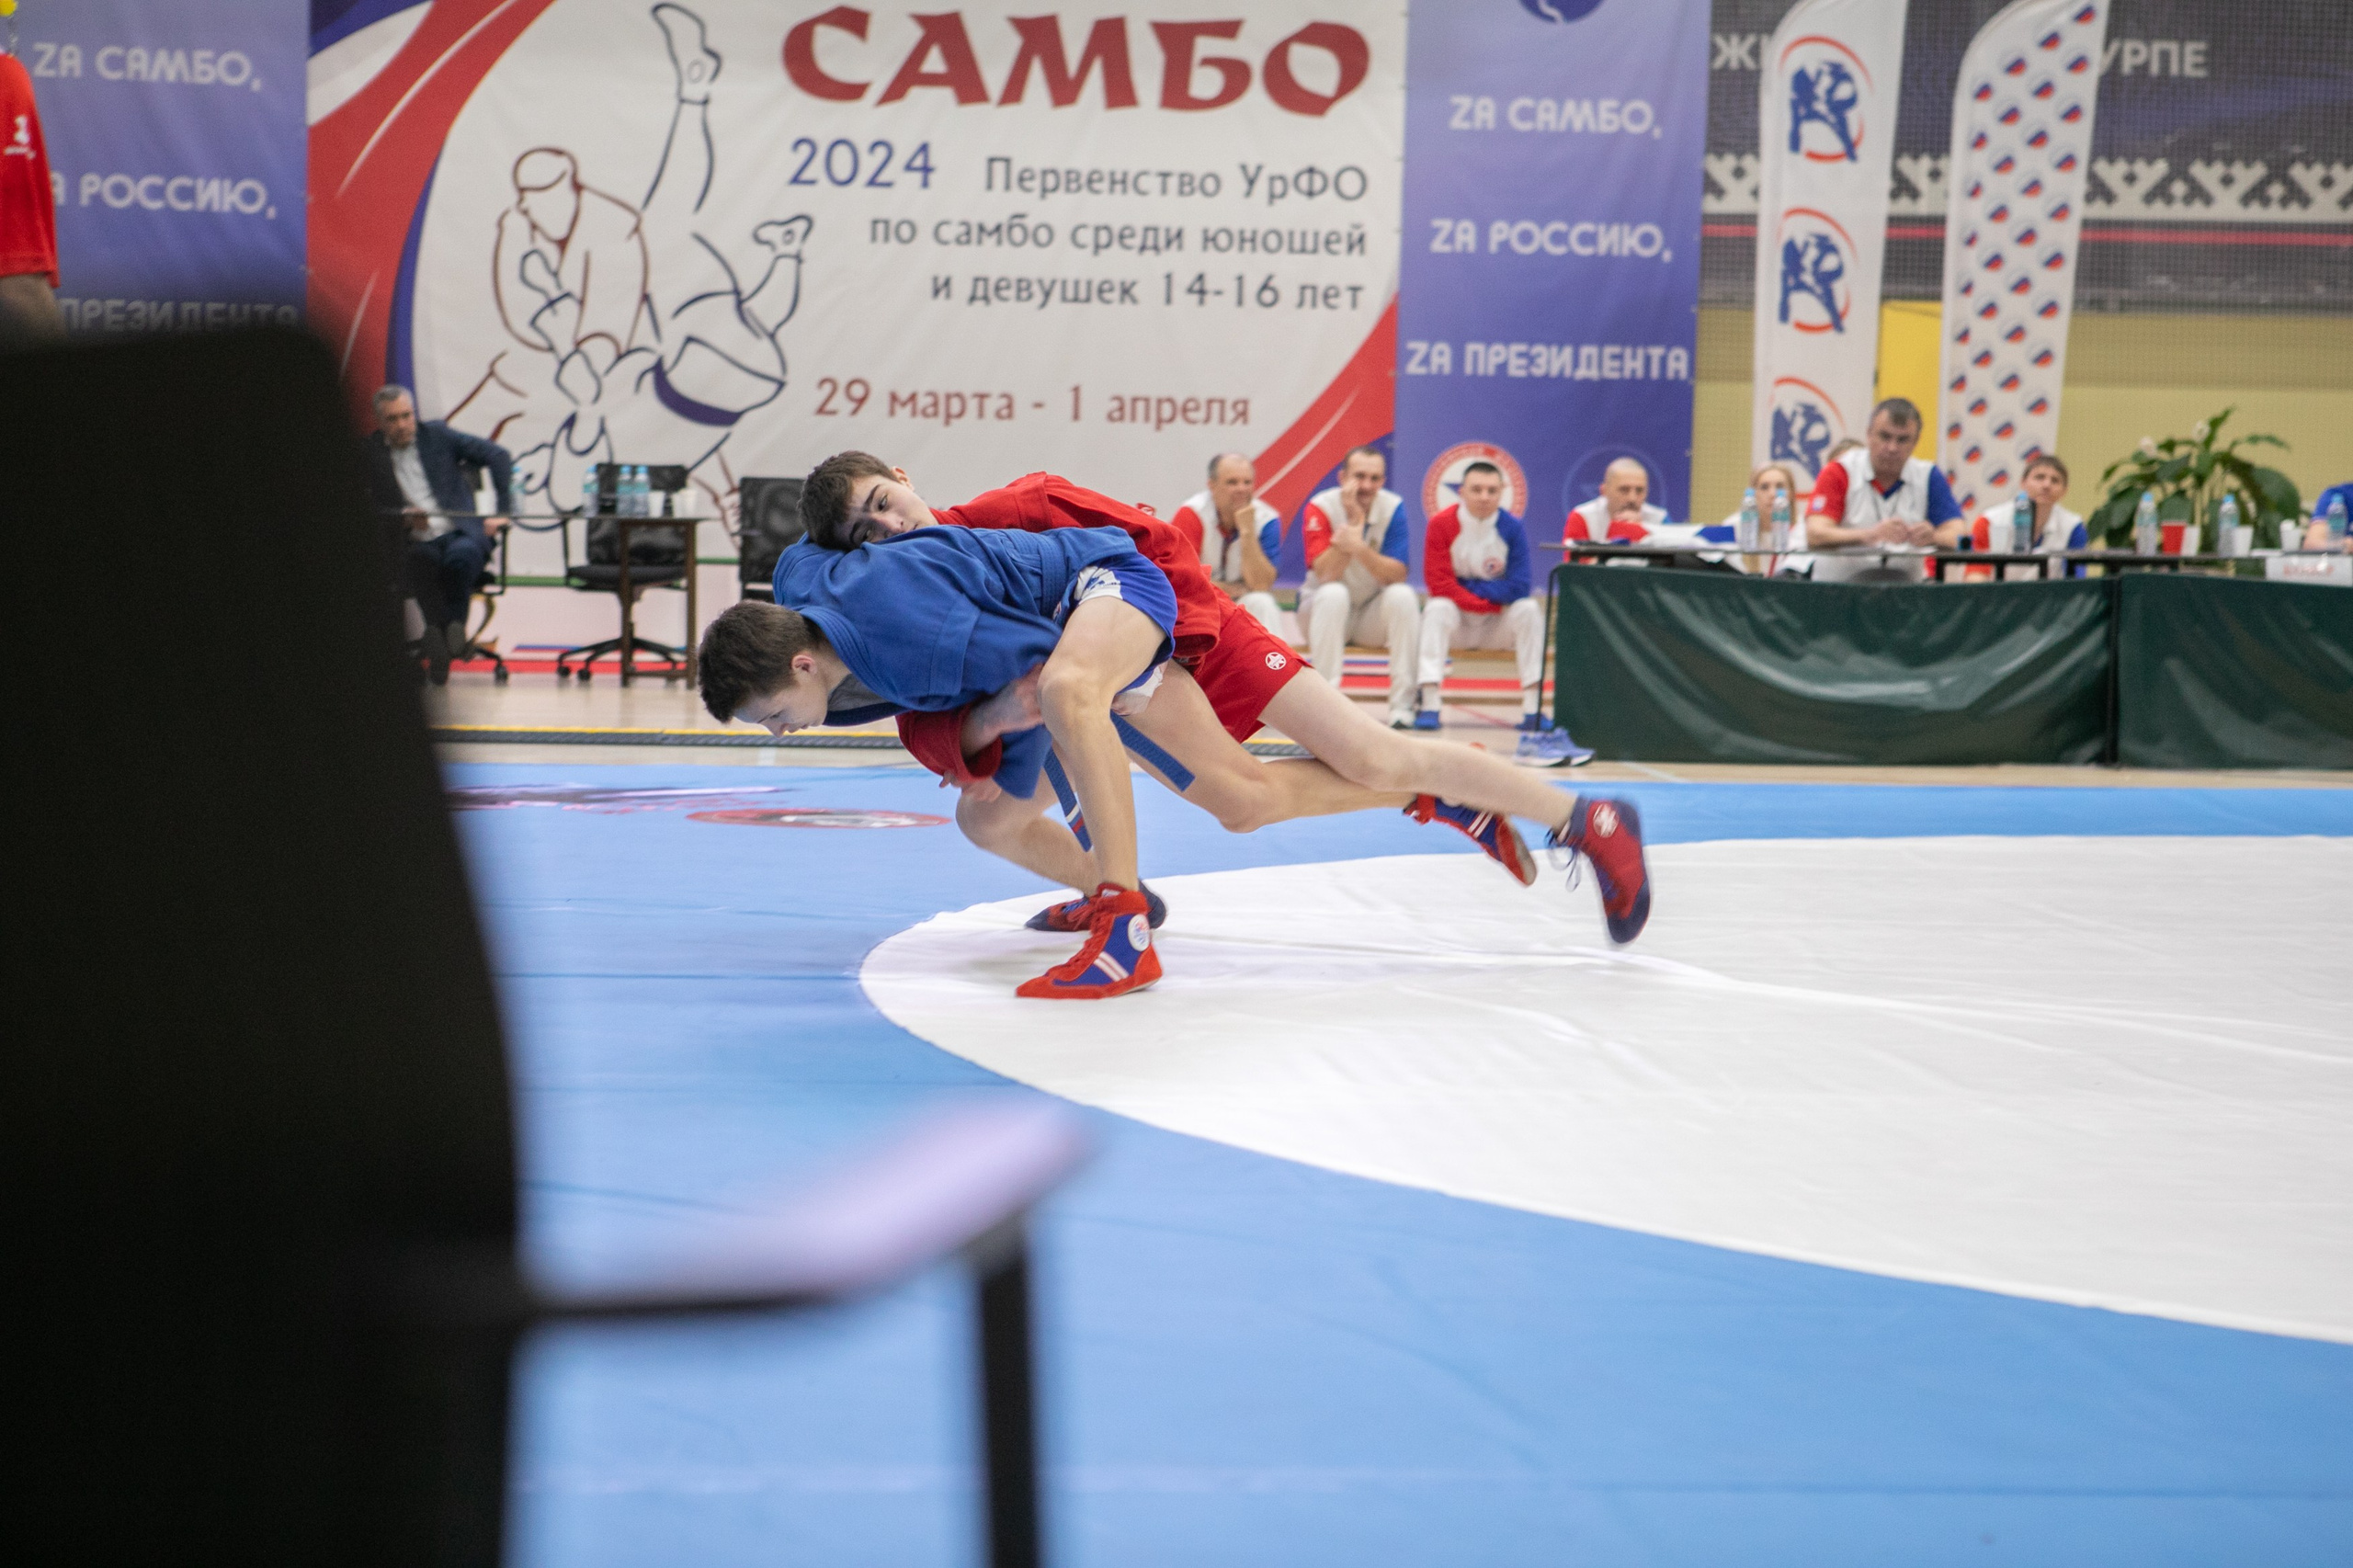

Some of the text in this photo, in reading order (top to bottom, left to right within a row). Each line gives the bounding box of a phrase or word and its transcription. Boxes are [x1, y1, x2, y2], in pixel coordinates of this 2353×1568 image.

[96, 45, 262, 92] САМБО,
[781, 5, 1370, 117] САМБО
[1507, 97, 1662, 140] САМБО,
[788, 137, 936, 189] 2024
[984, 156, 1370, 207] Первенство УрФО
[79, 172, 277, 219] РОССИЮ,
[870, 212, 1367, 257] по самбо среди юношей
[1488, 220, 1672, 263] РОССИЮ,
[931, 271, 1365, 311] и девушек 14-16 лет
[1464, 342, 1689, 381] ПРЕЗИДЕНТА
[814, 377, 870, 416] 29
[888, 390, 1016, 427] марта
[1070, 384, 1082, 423] 1
[1106, 394, 1251, 432] апреля
